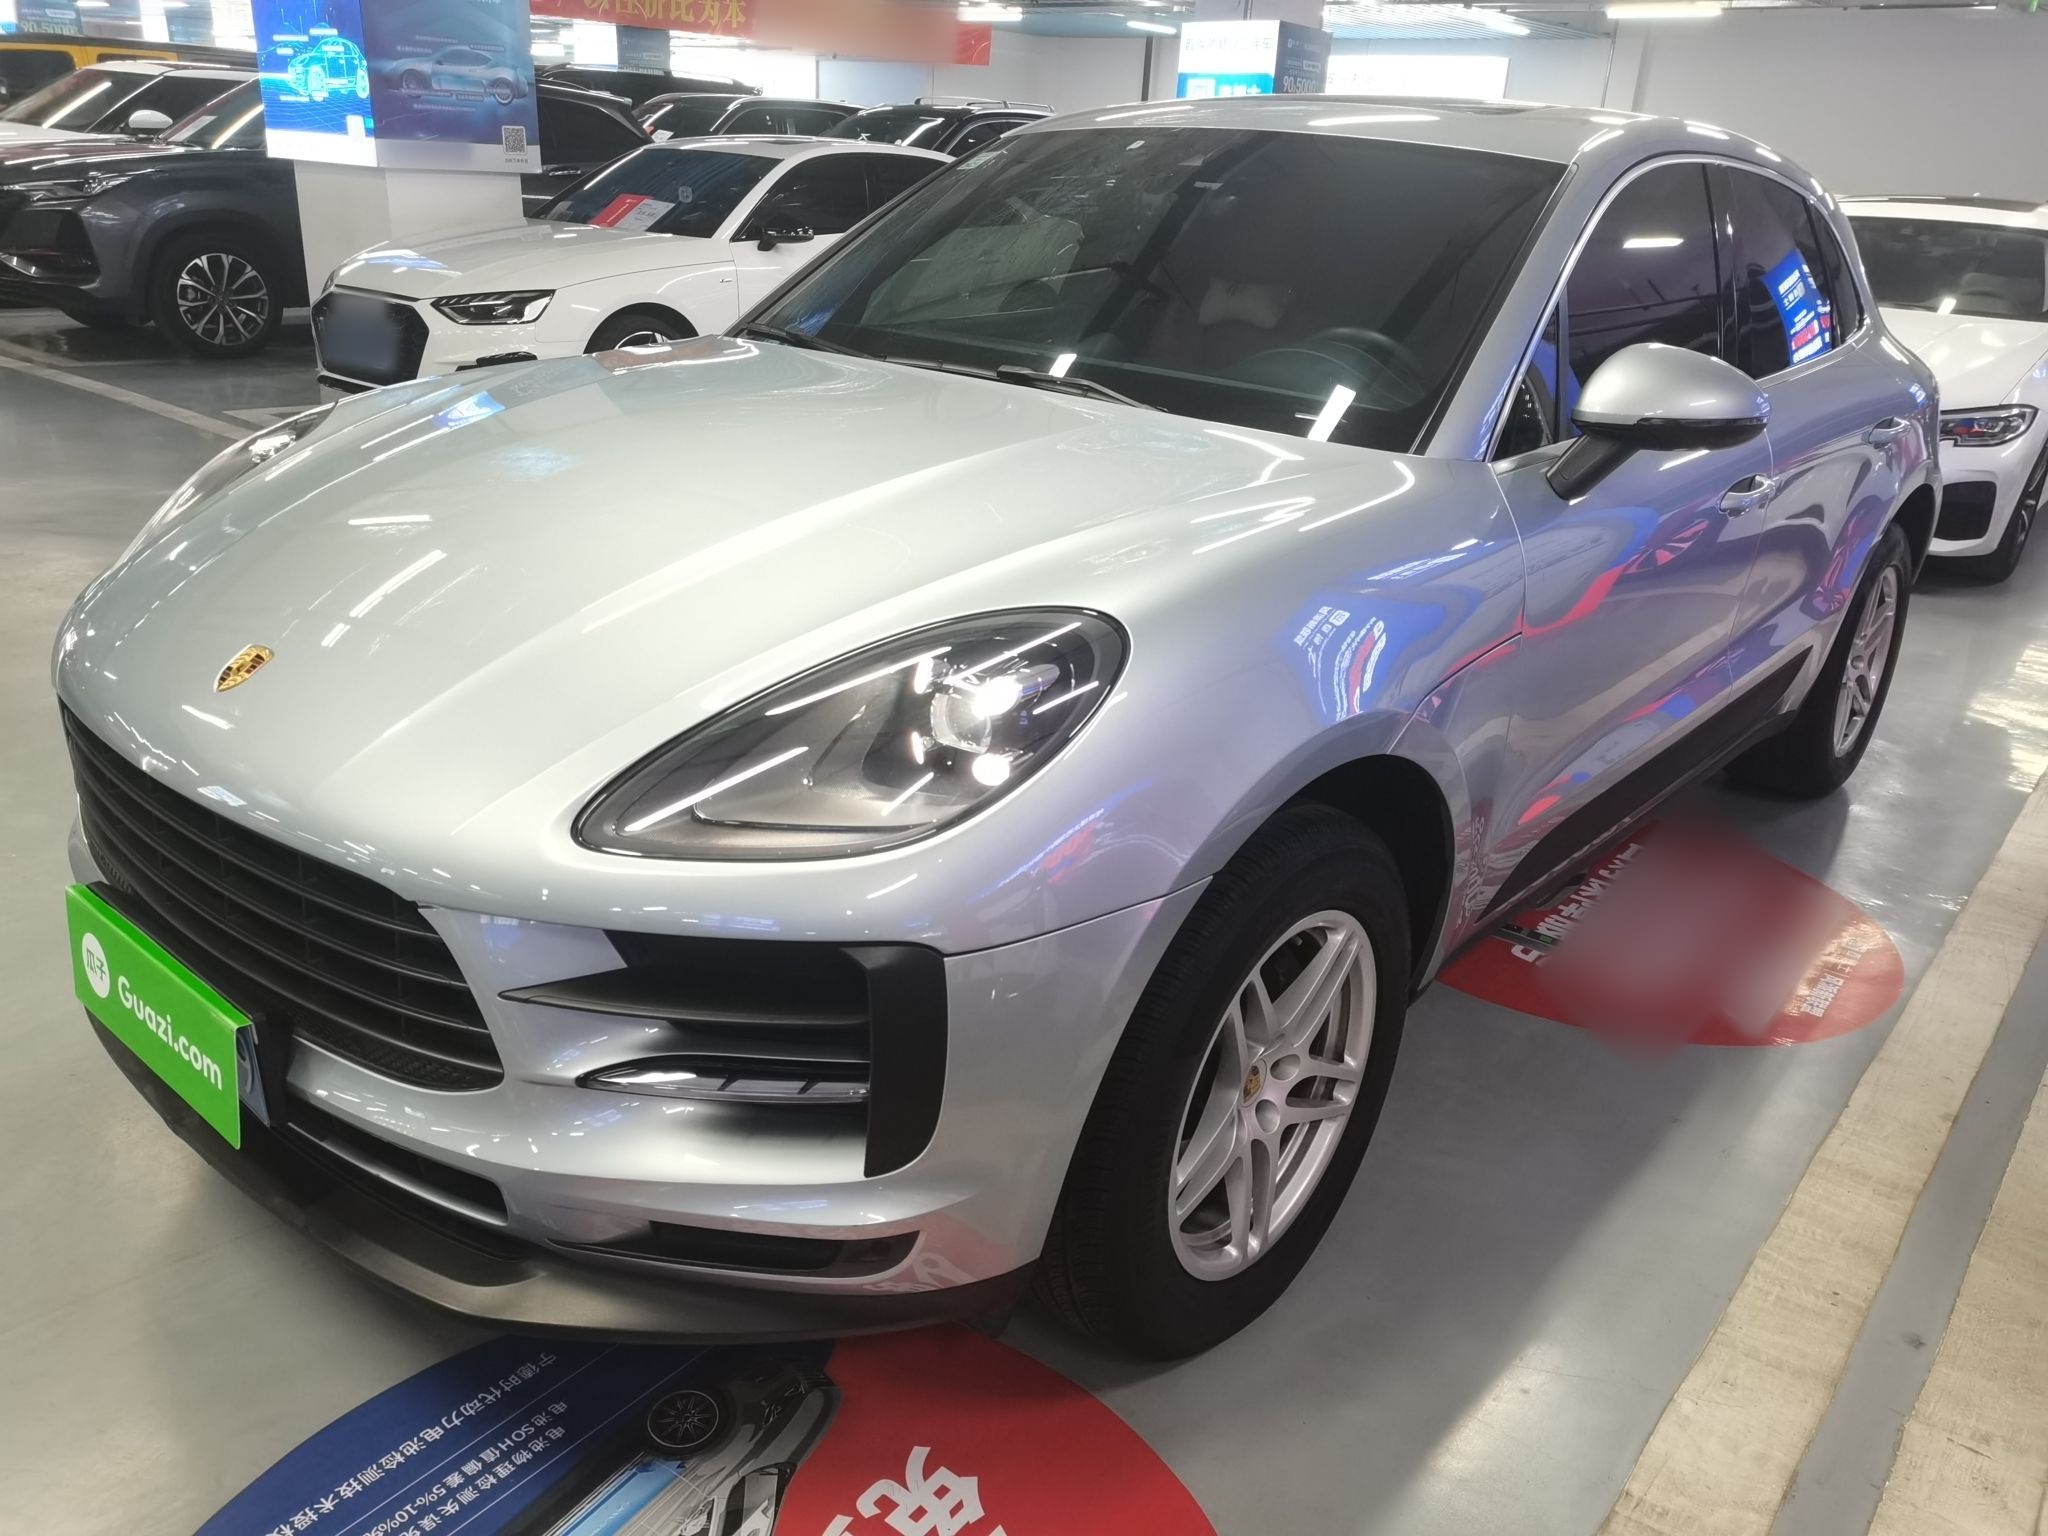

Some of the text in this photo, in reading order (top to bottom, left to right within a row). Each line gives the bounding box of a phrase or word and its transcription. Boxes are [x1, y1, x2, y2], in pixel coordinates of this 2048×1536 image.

[85, 947, 107, 983] 瓜子
[117, 975, 223, 1091] Guazi.com
[822, 1445, 986, 1536] 免
